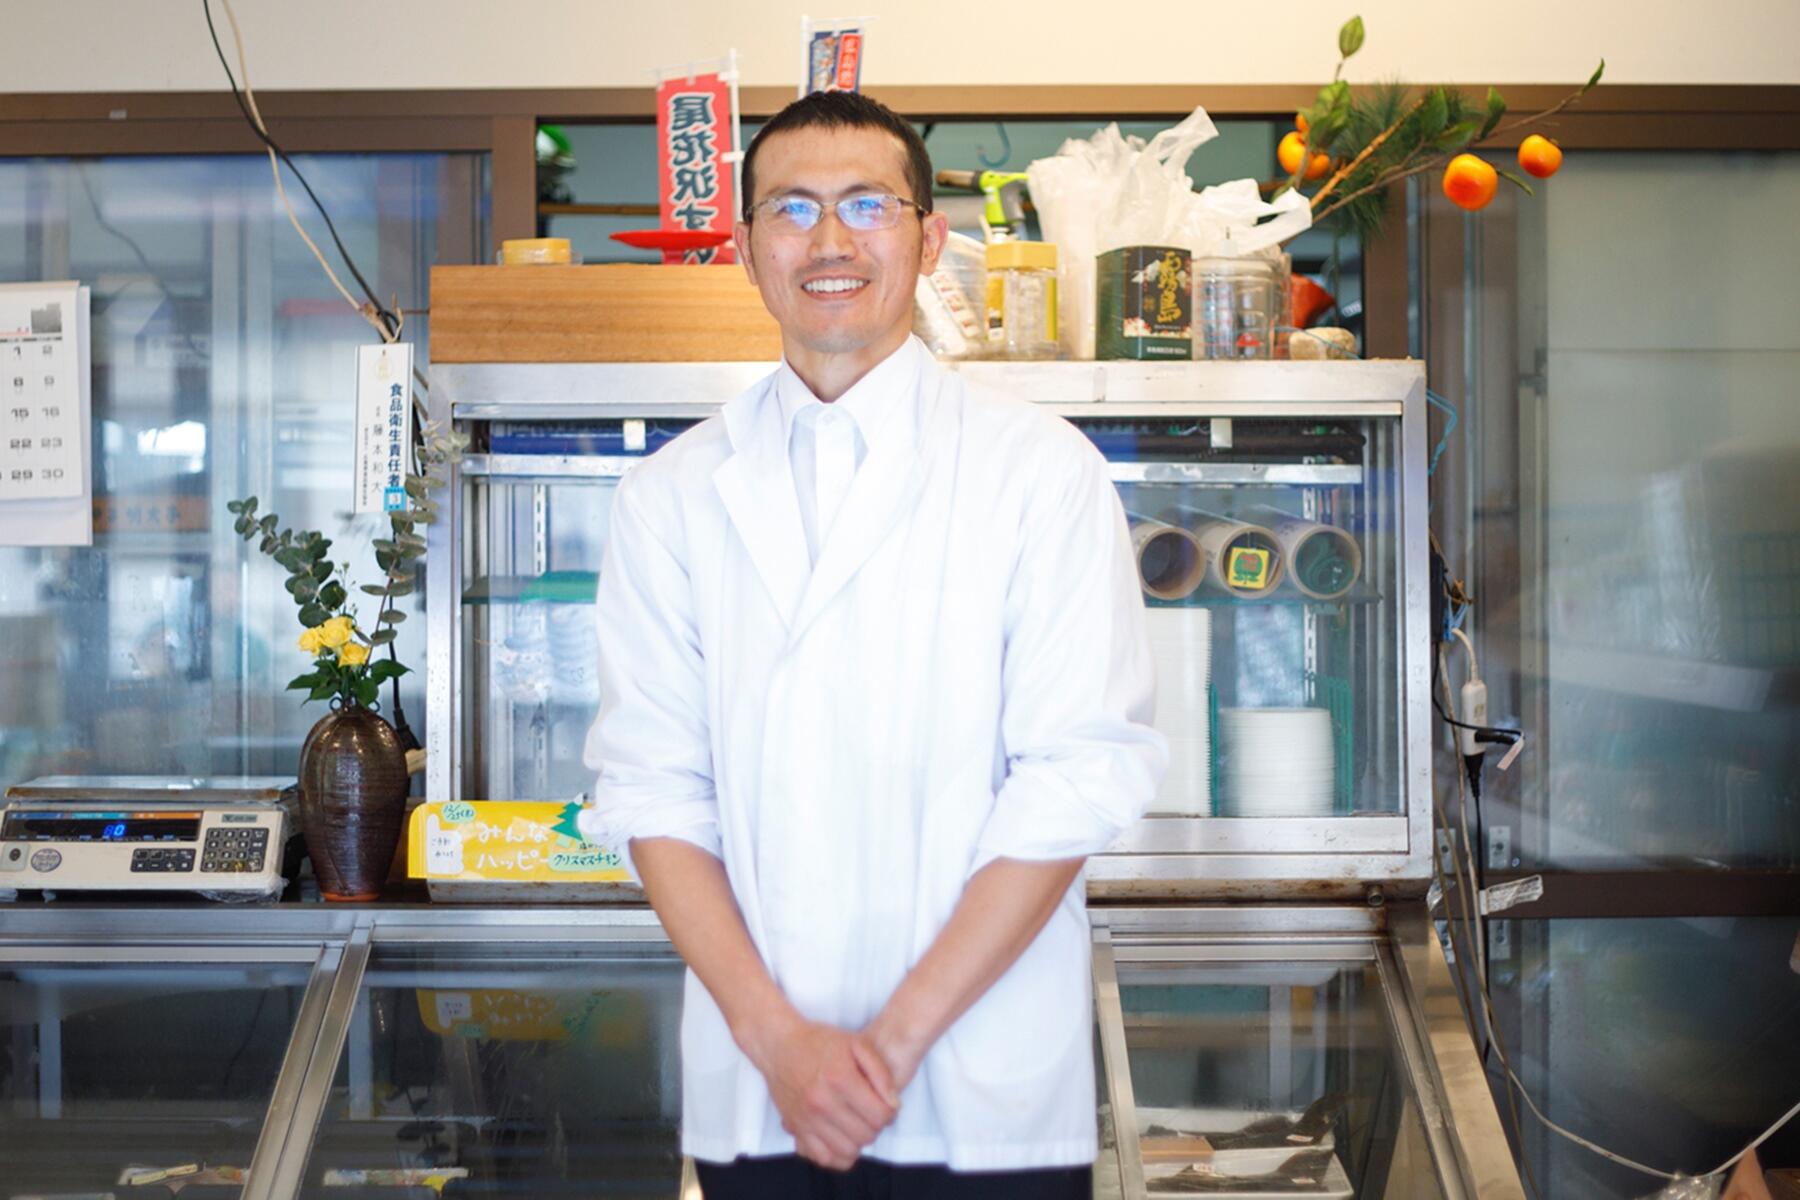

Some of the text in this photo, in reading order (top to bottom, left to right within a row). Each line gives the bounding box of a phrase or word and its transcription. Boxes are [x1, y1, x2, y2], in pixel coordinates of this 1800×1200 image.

[10, 437, 62, 449] 22 23
[389, 383, 403, 487] 食品衛生責任者
[11, 468, 64, 480] 29 30
[477, 821, 549, 844] みんな
[475, 849, 549, 871] ハッピー
[554, 851, 621, 866] クリスマスチキン
